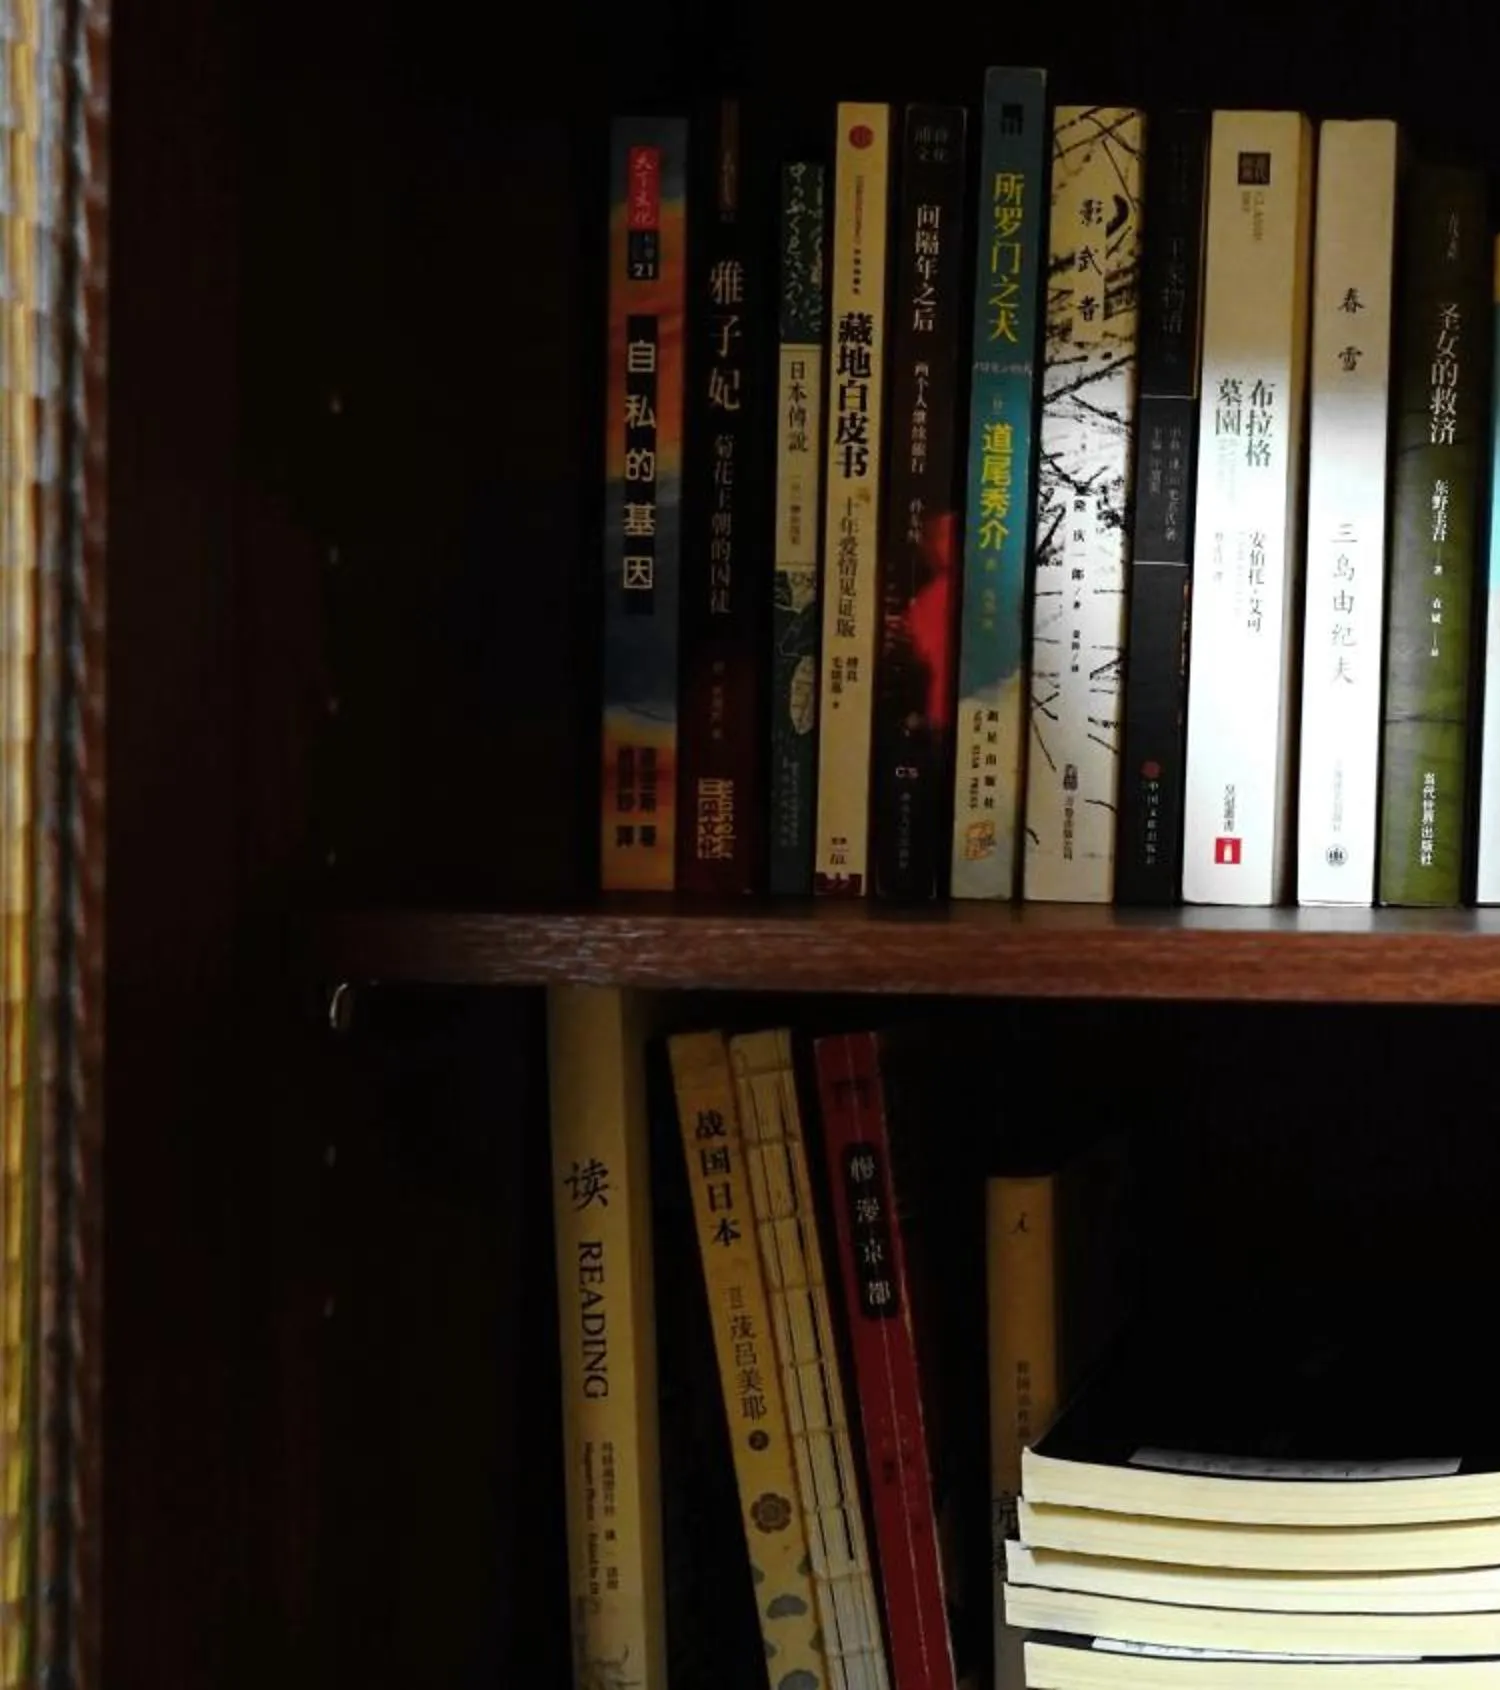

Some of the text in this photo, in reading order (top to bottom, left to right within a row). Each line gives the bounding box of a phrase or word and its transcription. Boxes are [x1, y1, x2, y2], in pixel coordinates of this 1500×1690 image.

[911, 203, 942, 333] 间隔年之后
[988, 172, 1025, 343] 所罗门之犬
[1079, 199, 1104, 322] 影武者
[708, 258, 745, 410] 雅子妃
[837, 313, 874, 478] 藏地白皮书
[1337, 288, 1365, 372] 春雪
[1429, 303, 1462, 444] 圣女的救济
[623, 340, 656, 590] 自私的基因
[979, 422, 1013, 550] 道尾秀介
[1246, 378, 1276, 467] 布拉格
[1431, 480, 1448, 542] 东野圭吾
[1330, 523, 1358, 684] 三岛由纪夫
[1421, 772, 1436, 866] 当代世界出版社
[564, 1159, 610, 1212] 读
[696, 1109, 742, 1248] 战国日本
[578, 1239, 610, 1399] READING
